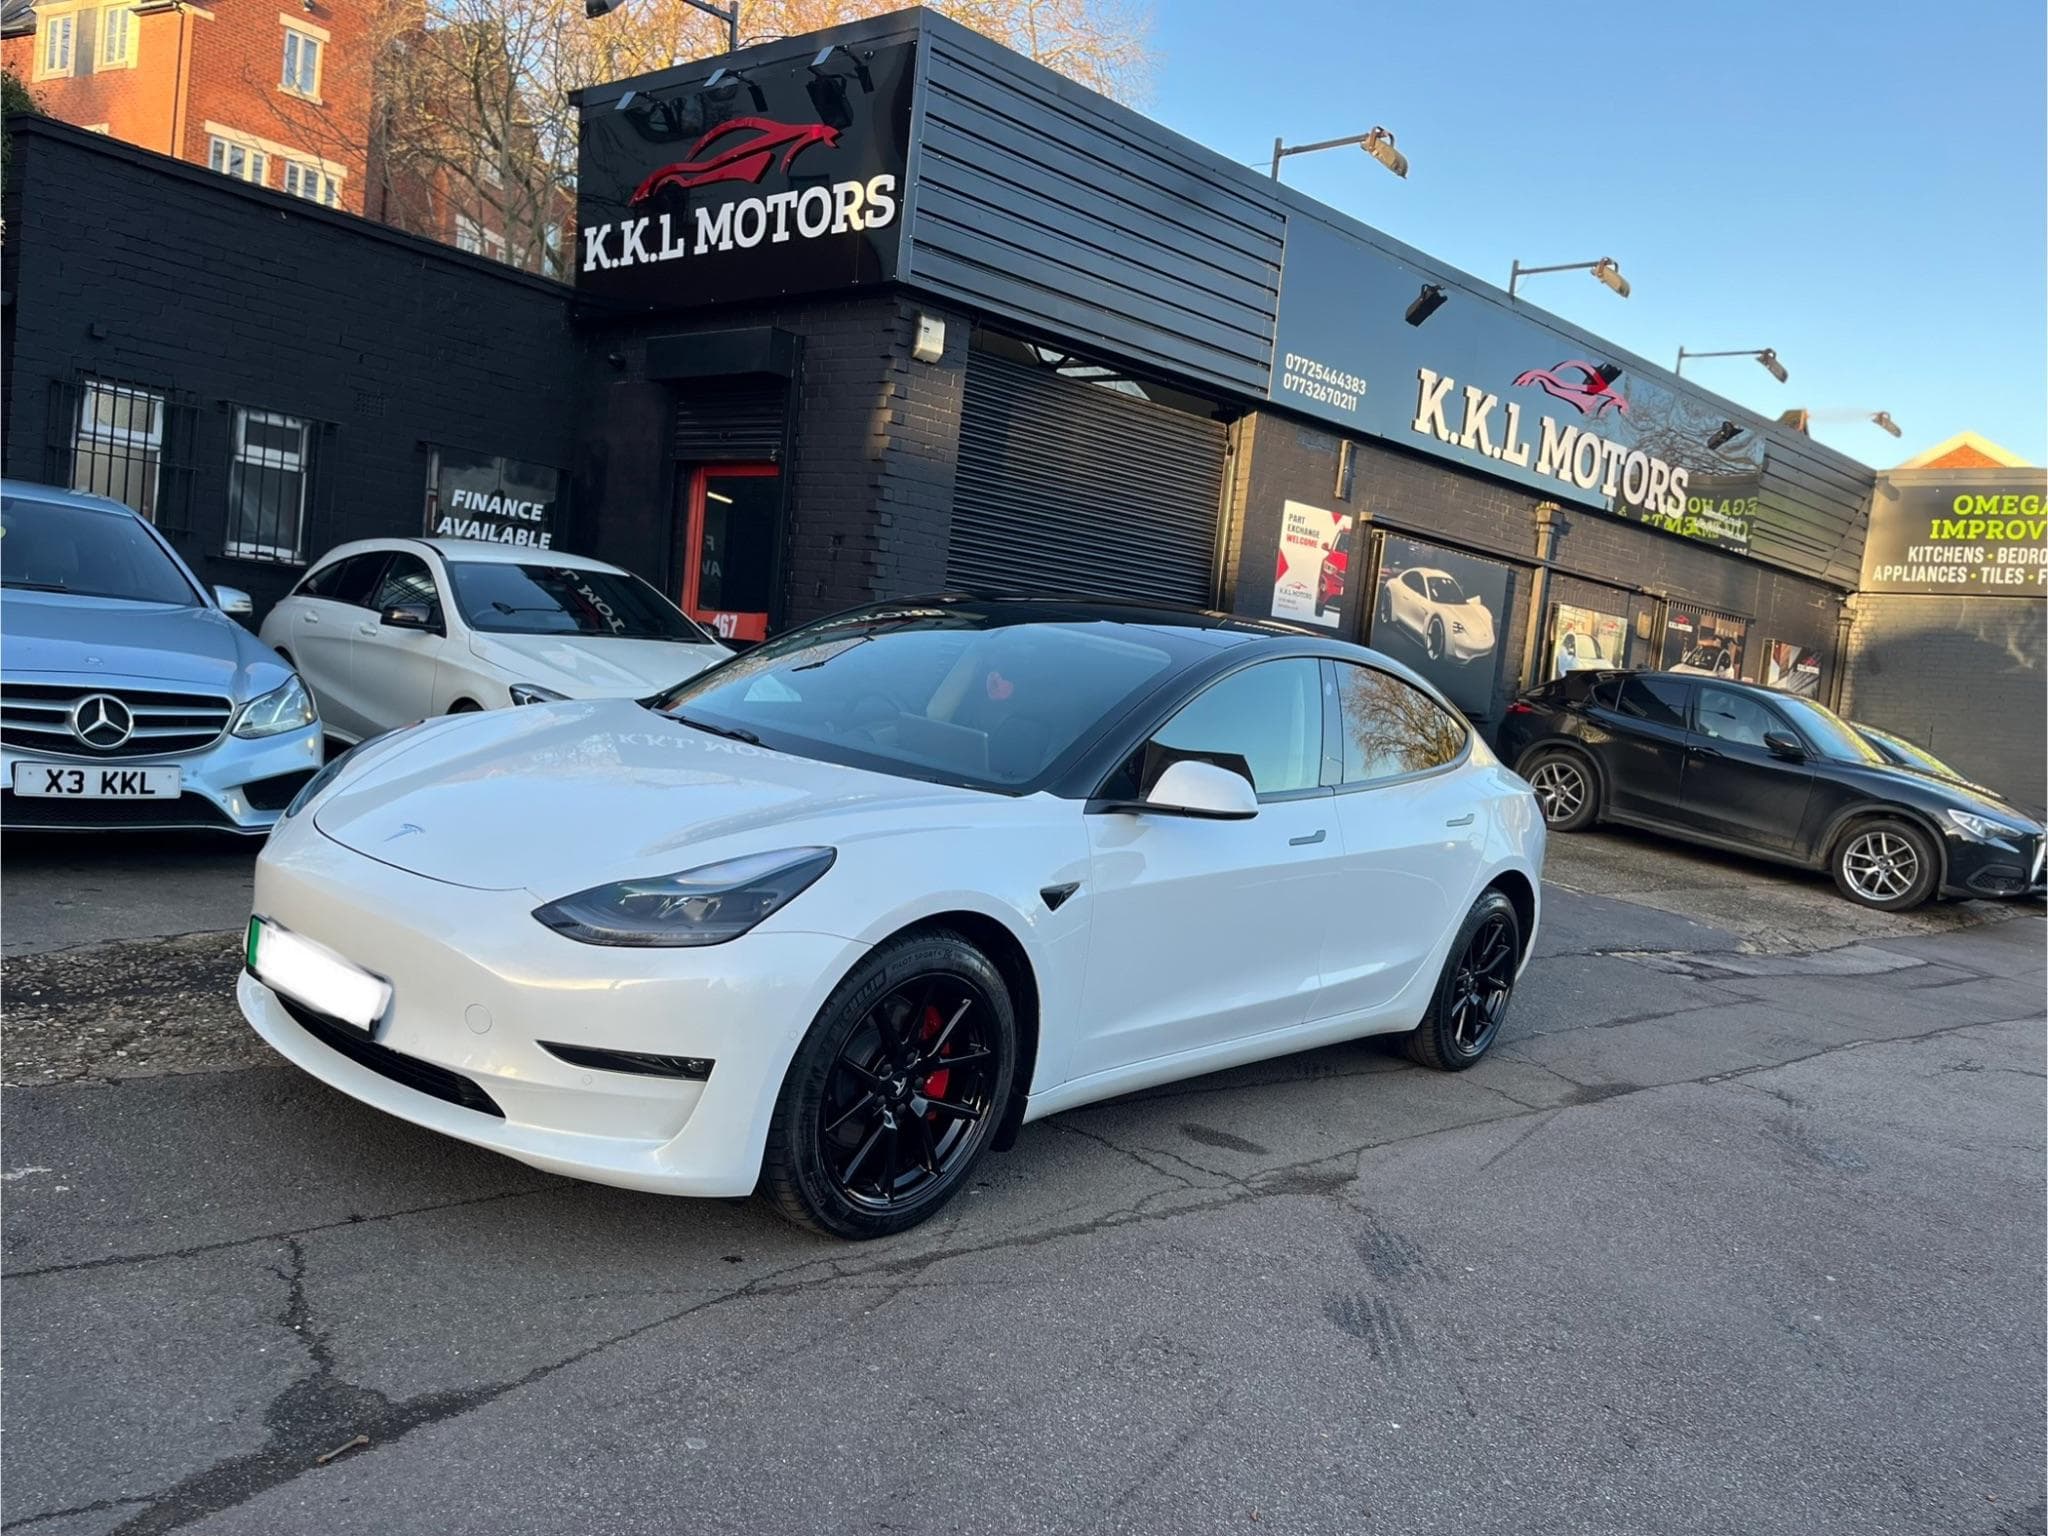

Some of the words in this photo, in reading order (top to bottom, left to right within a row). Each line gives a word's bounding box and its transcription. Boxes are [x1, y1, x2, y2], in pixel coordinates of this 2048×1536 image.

[583, 213, 685, 272] K.K.L
[693, 173, 896, 255] MOTORS
[1285, 353, 1366, 395] 07725464383
[1283, 372, 1358, 412] 07732670211
[1412, 367, 1531, 468] K.K.L
[1534, 415, 1689, 520] MOTORS
[451, 489, 544, 521] FINANCE
[436, 516, 553, 550] AVAILABLE
[1287, 524, 1320, 538] EXCHANGE
[1288, 514, 1305, 525] PART
[1929, 519, 2047, 540] IMPROV
[1286, 534, 1317, 548] WELCOME
[1907, 546, 1985, 564] KITCHENS
[1872, 564, 1968, 583] APPLIANCES
[1980, 566, 2025, 585] TILES
[45, 768, 85, 794] X3
[100, 770, 156, 795] KKL
